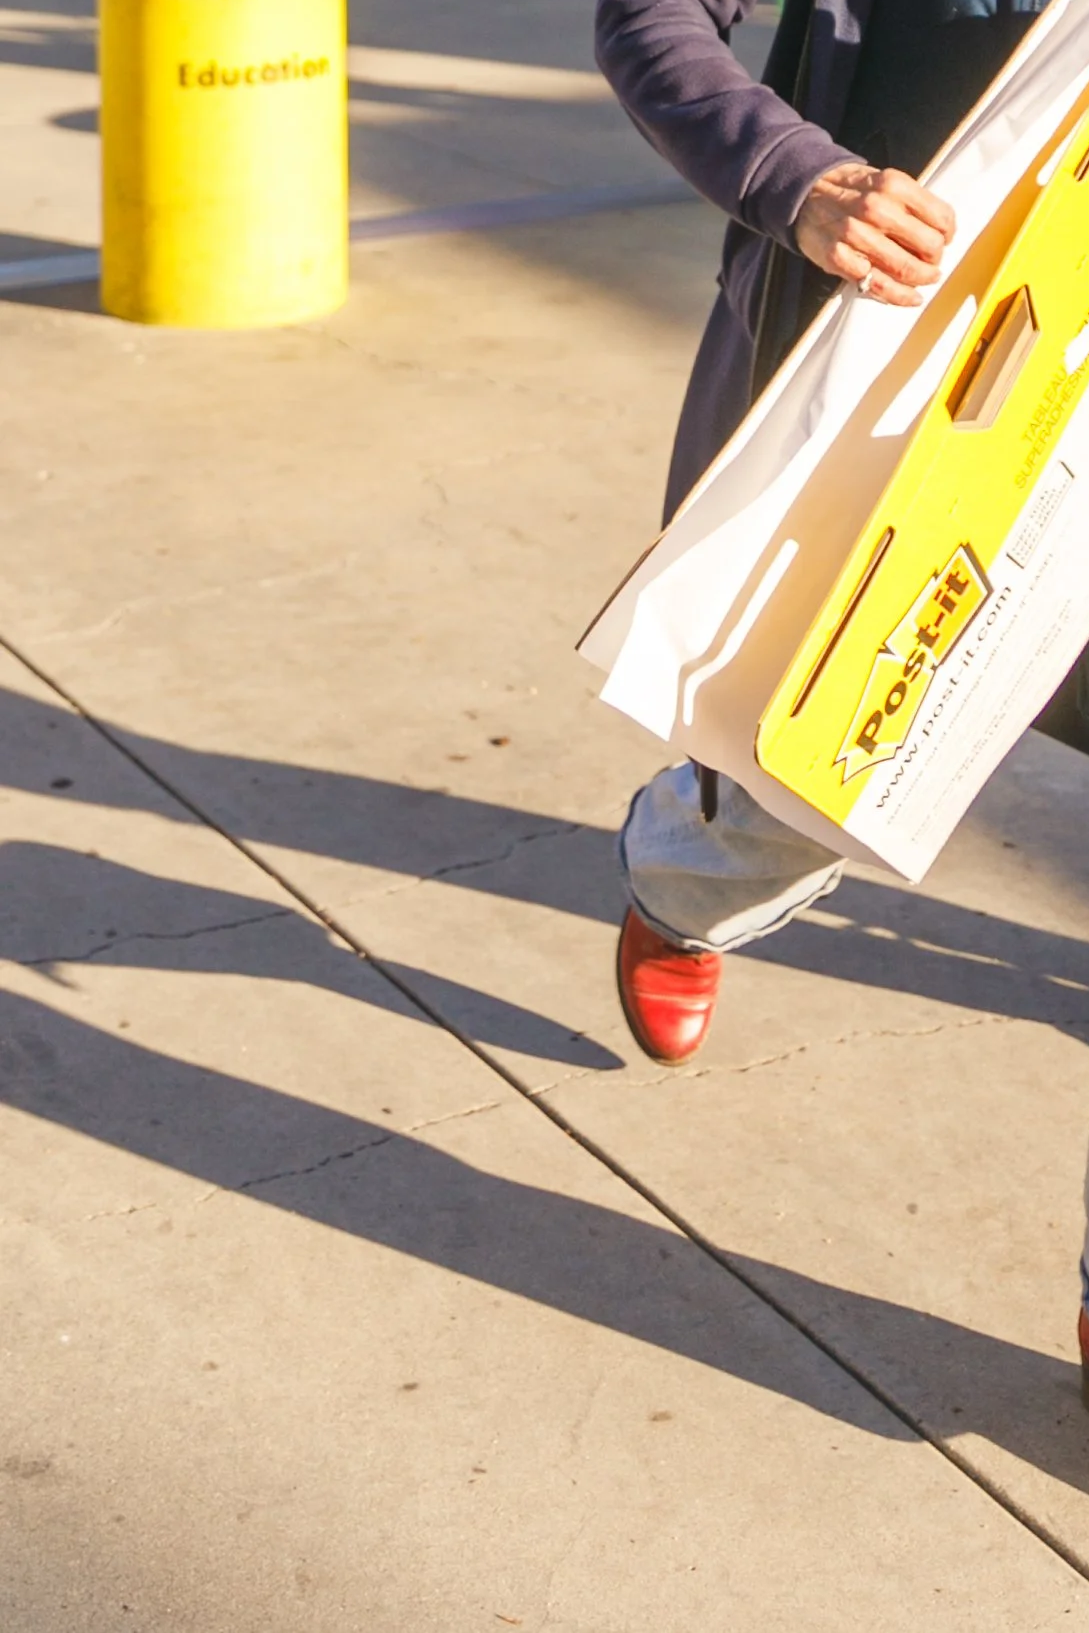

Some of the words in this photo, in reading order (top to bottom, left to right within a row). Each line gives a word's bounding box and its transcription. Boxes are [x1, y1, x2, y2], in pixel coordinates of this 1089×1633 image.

[178, 54, 330, 88] Education
[1021, 366, 1068, 443] TABLEAU
[856, 570, 970, 755] Post-it
[876, 585, 1012, 808] www.post-it.com
